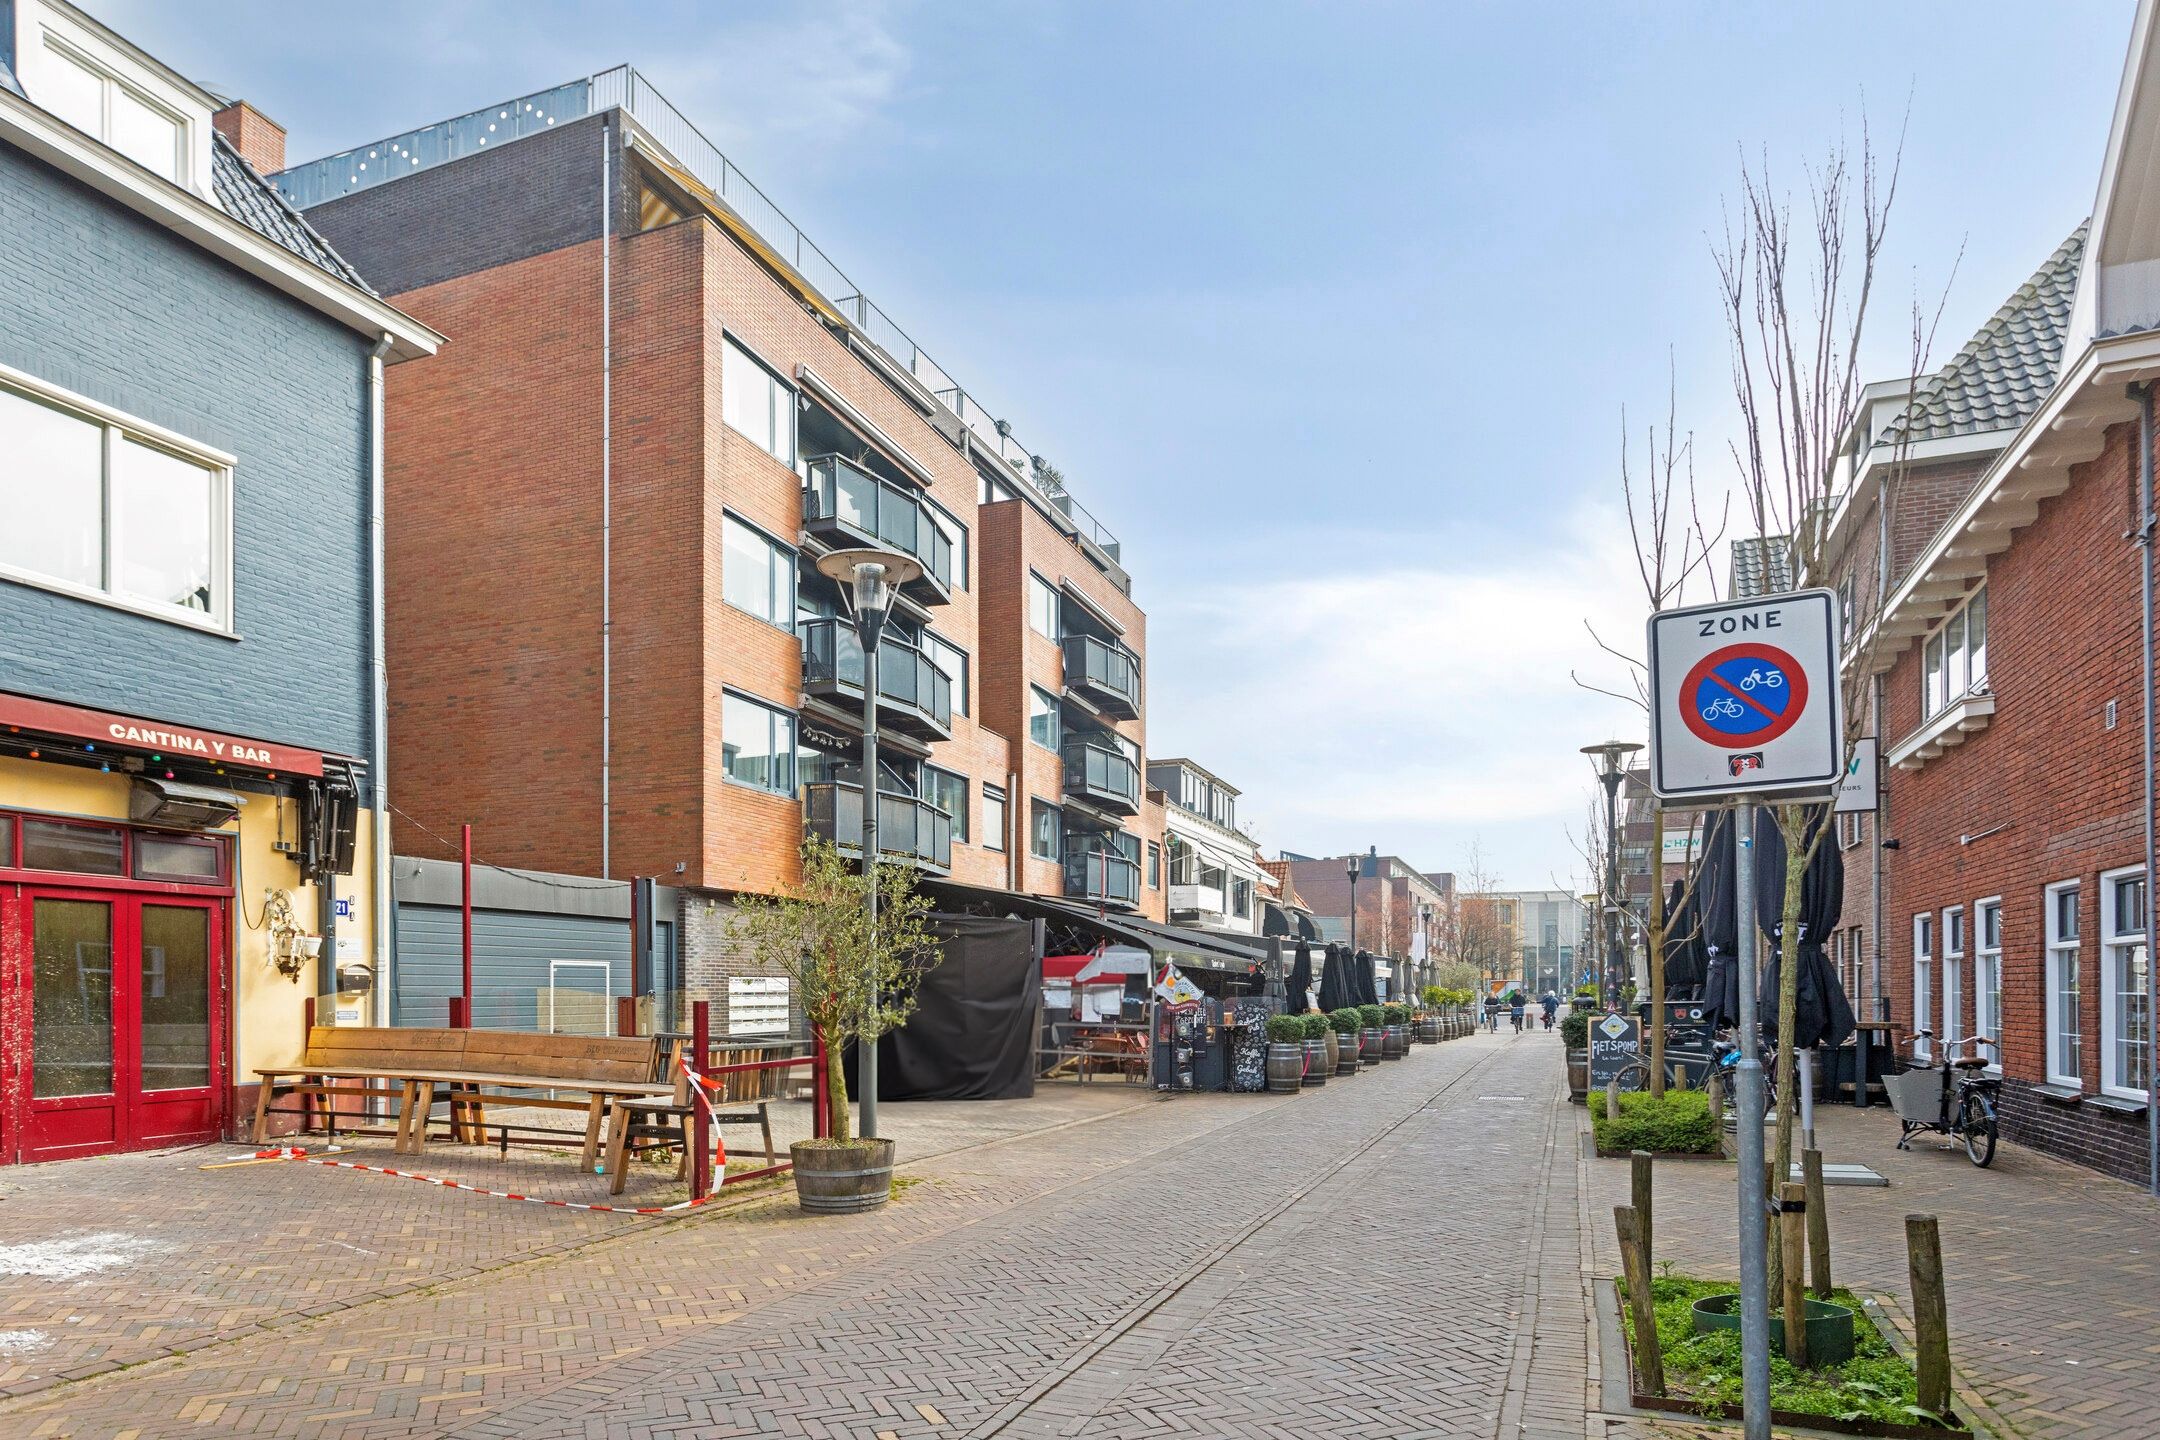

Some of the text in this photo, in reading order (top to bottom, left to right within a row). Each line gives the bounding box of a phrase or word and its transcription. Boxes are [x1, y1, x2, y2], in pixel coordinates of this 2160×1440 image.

[1699, 610, 1782, 637] ZONE
[108, 723, 272, 764] CANTINA Y BAR
